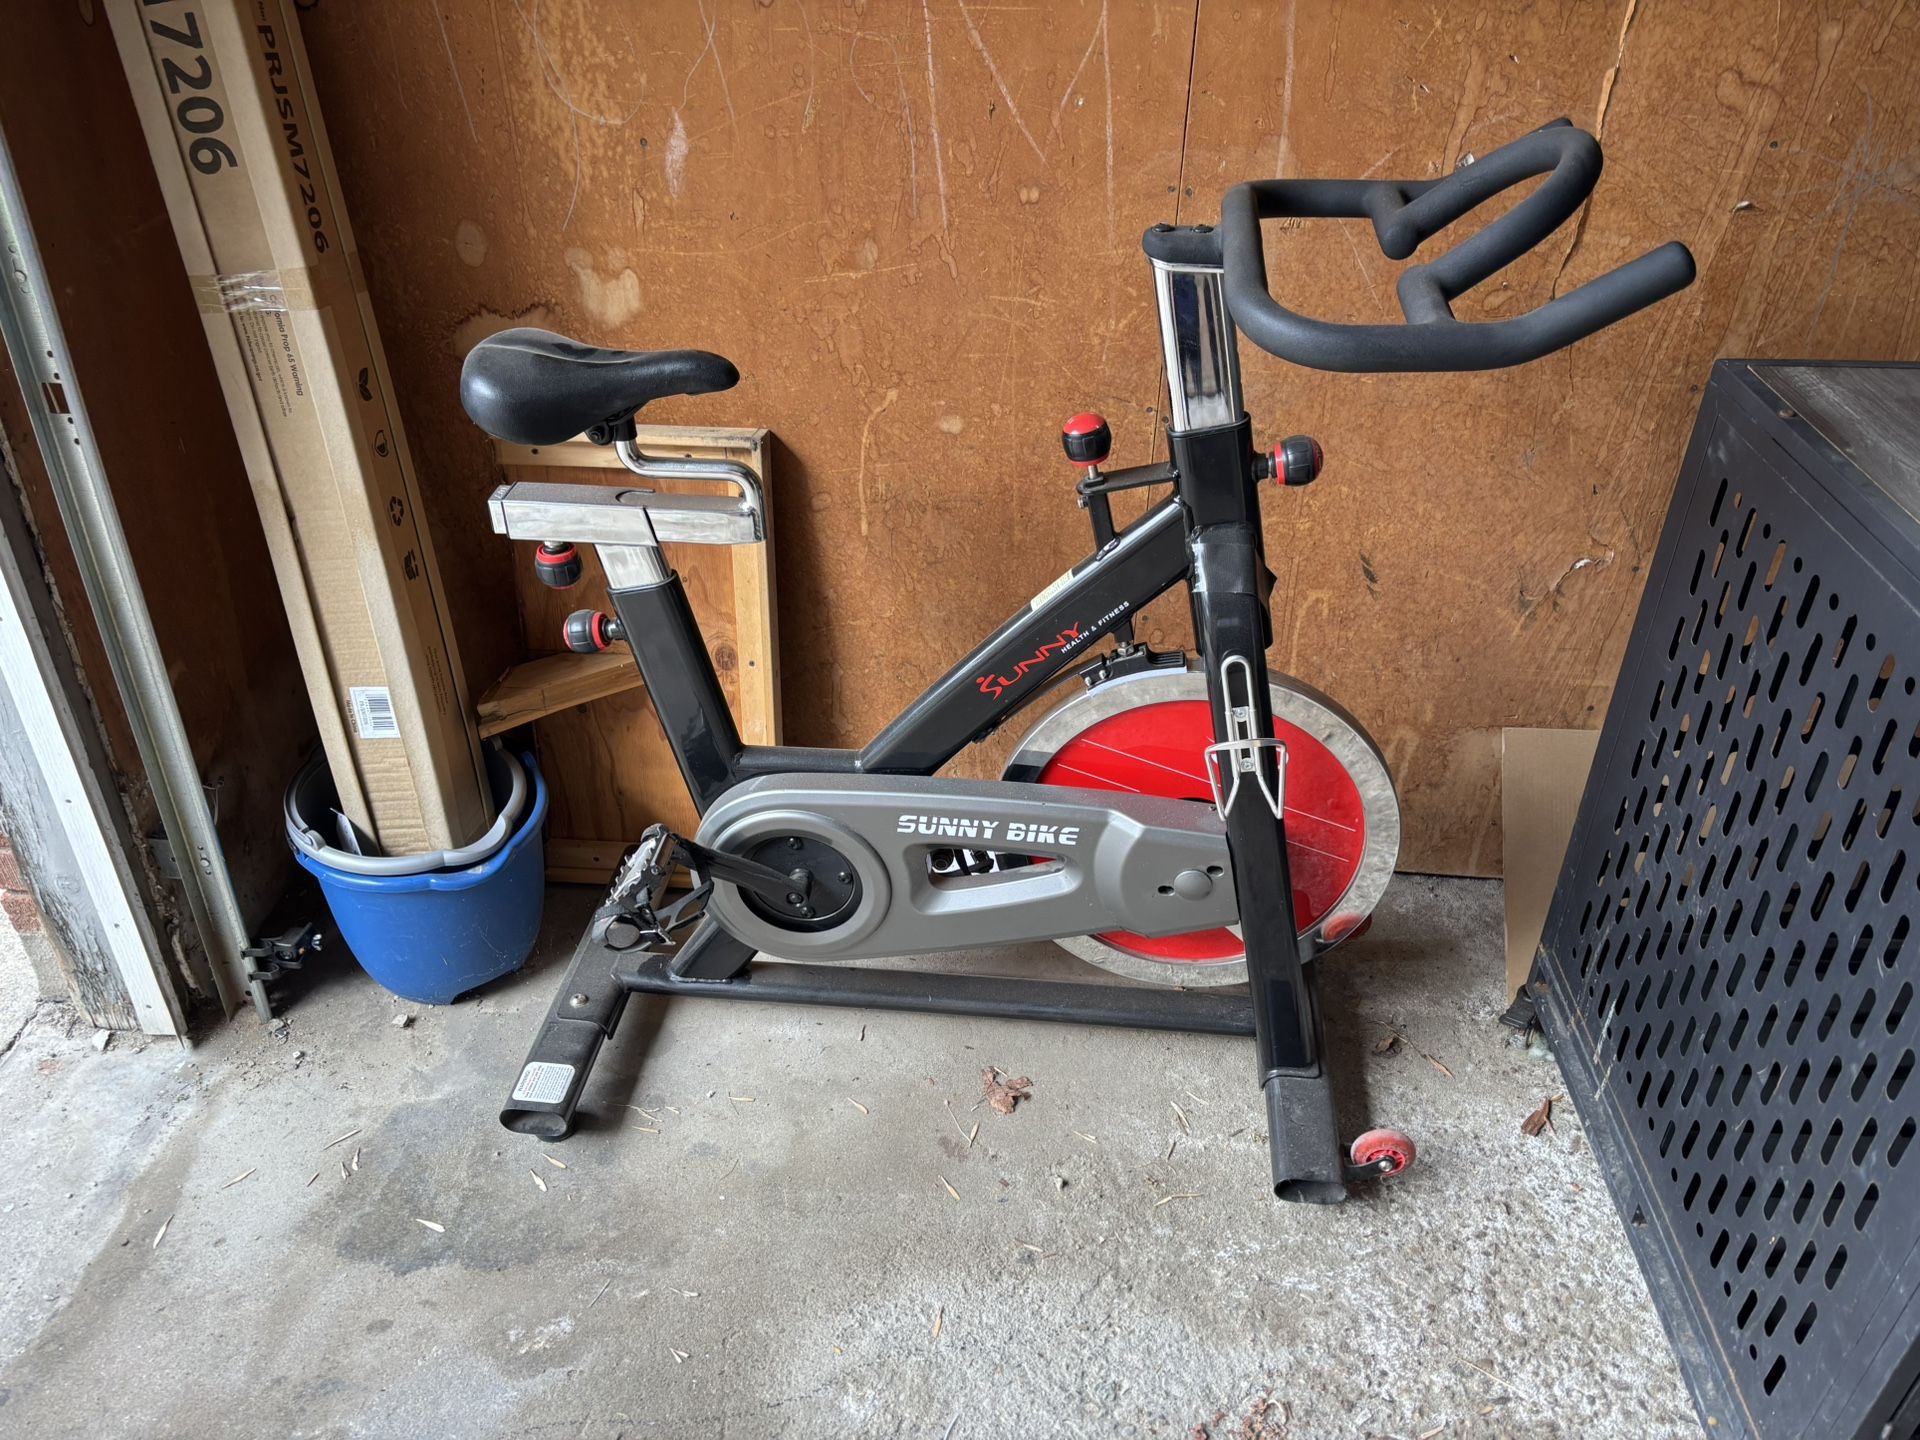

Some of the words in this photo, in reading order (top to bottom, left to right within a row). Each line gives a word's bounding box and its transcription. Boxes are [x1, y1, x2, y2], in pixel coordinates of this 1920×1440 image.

[143, 0, 238, 175] 7206
[257, 25, 329, 254] PRJSM7206
[281, 333, 291, 352] Prop
[287, 353, 295, 363] 65
[290, 364, 304, 396] Warning
[1061, 630, 1090, 654] HEALTH
[1098, 601, 1130, 627] FITNESS
[976, 621, 1079, 700] SUNNY
[897, 815, 999, 839] SUNNY
[1006, 822, 1081, 845] BIKE
